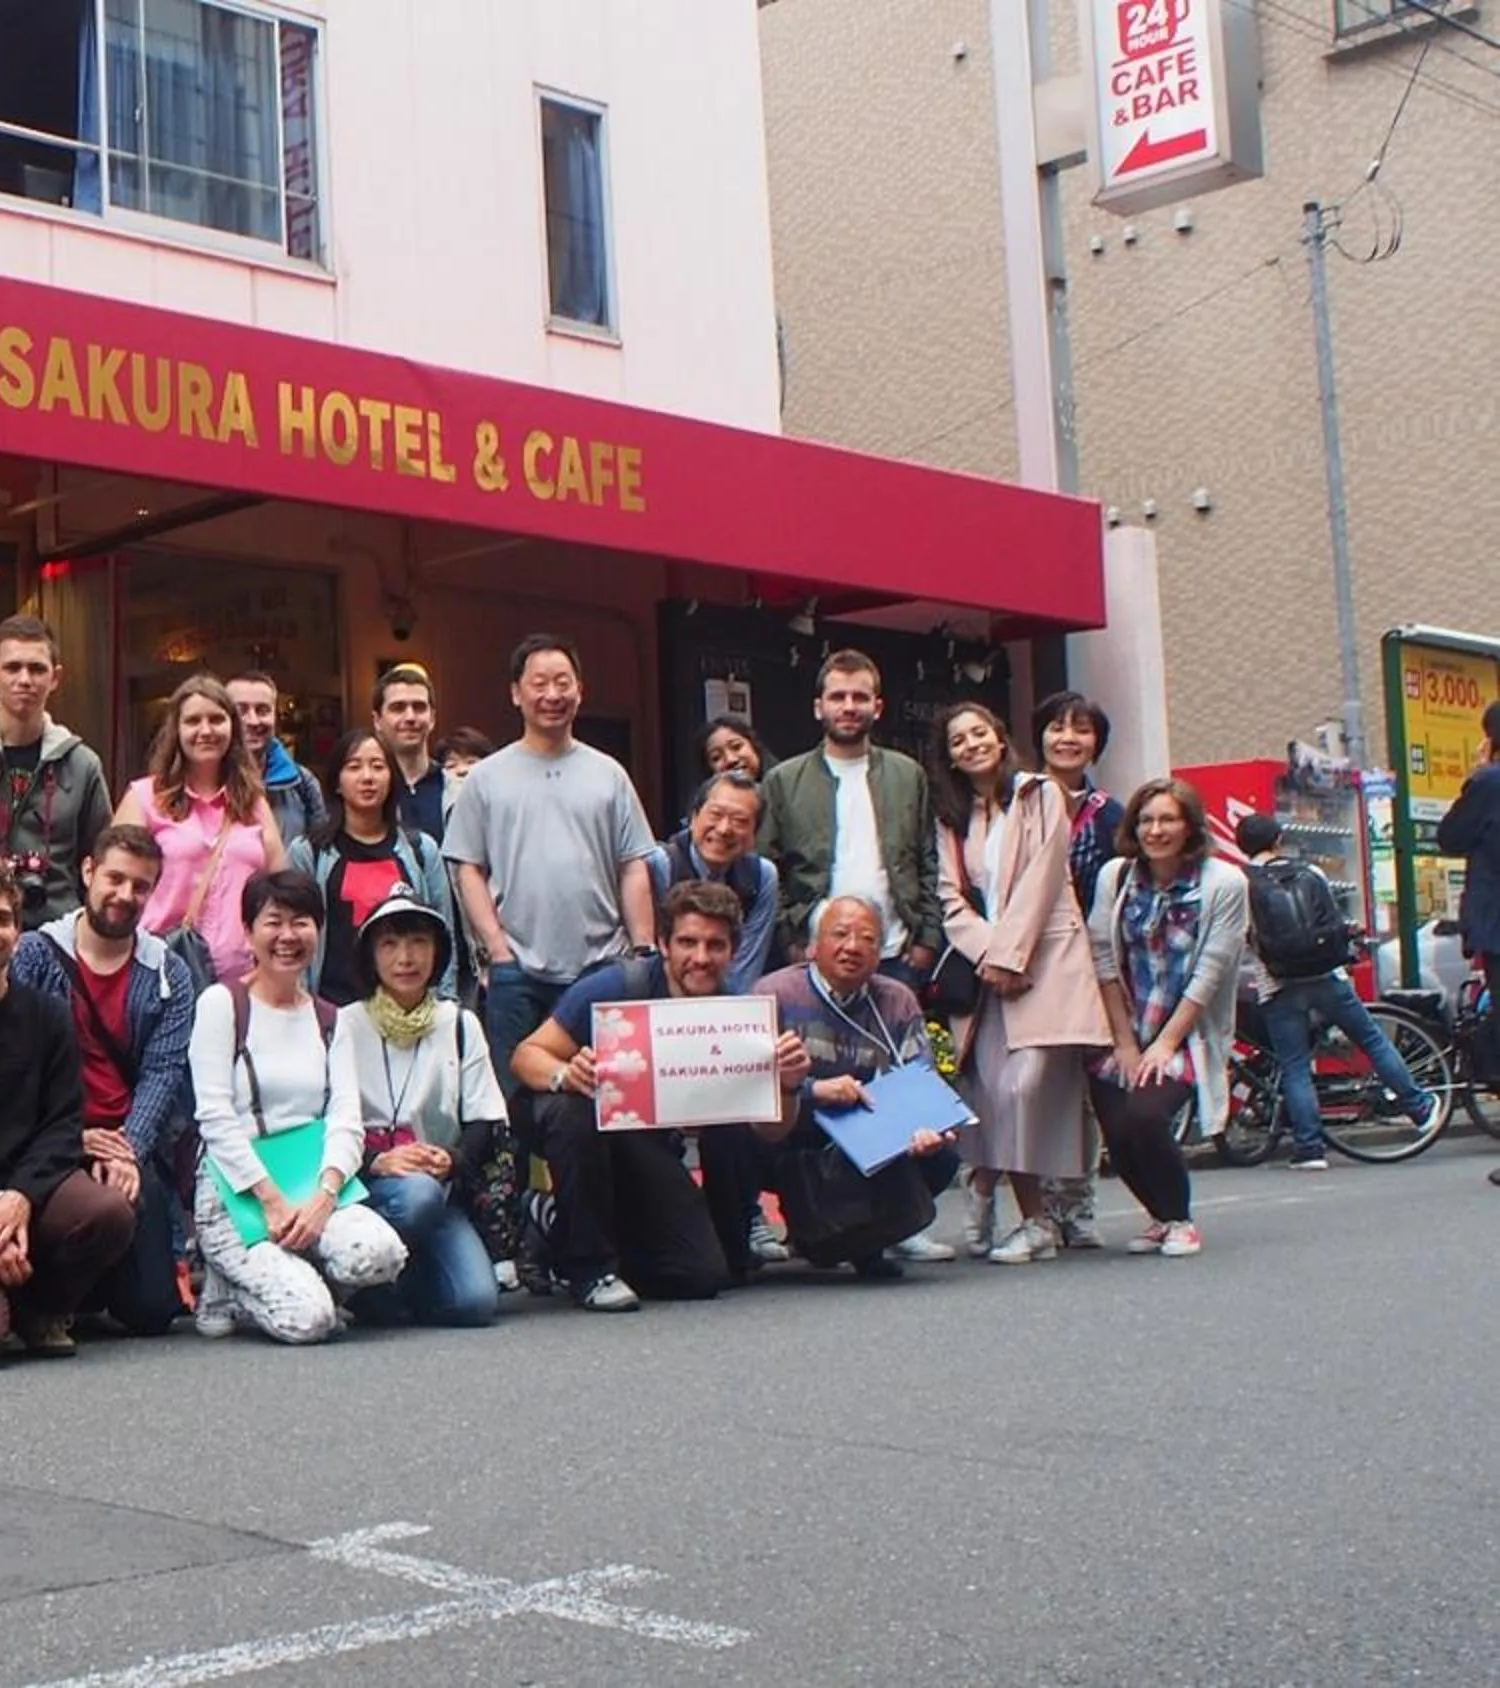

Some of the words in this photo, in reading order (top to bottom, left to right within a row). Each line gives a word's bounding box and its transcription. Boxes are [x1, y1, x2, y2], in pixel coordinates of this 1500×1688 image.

[1111, 48, 1197, 96] CAFE
[278, 381, 457, 484] HOTEL
[473, 420, 509, 493] &
[522, 430, 647, 512] CAFE
[656, 1024, 719, 1037] SAKURA
[721, 1022, 769, 1034] HOTEL
[710, 1044, 722, 1056] &
[659, 1065, 719, 1078] SAKURA
[722, 1062, 772, 1075] HOUSE
